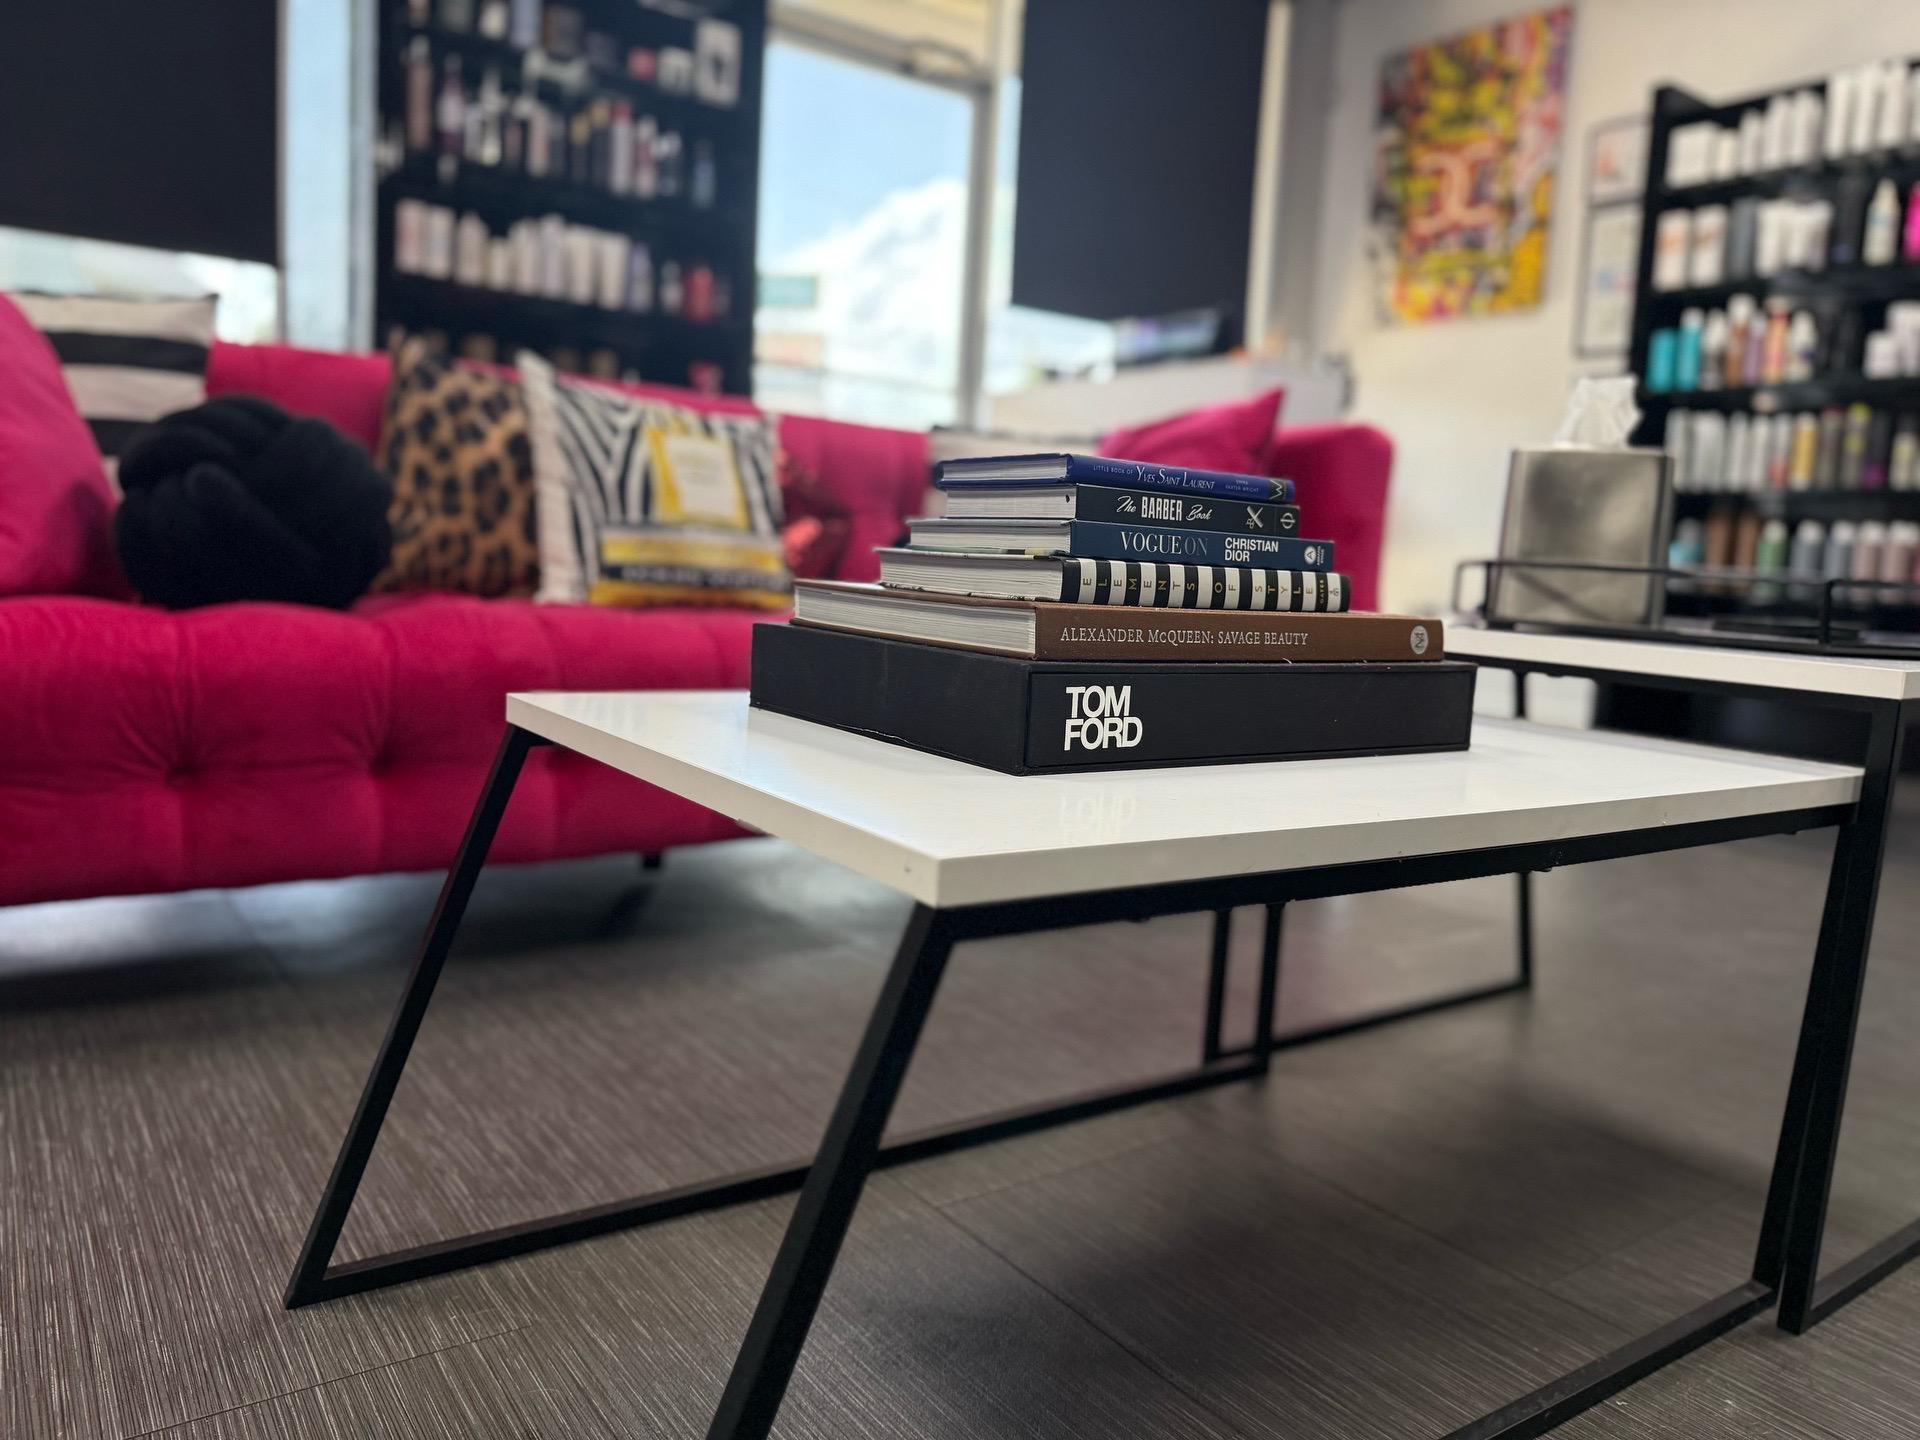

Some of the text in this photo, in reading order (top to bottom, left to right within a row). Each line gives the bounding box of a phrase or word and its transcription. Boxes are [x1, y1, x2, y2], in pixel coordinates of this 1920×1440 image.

[1136, 465, 1155, 483] YVES
[1157, 468, 1180, 486] SAINT
[1182, 471, 1215, 490] LAURENT
[1116, 495, 1213, 521] The BARBER Book
[1120, 531, 1208, 556] VOGUE ON
[1224, 537, 1279, 553] CHRISTIAN
[1224, 550, 1250, 562] DIOR
[1060, 627, 1309, 646] ALEXANDER McQUEEN: SAVAGE BEAUTY
[1065, 685, 1131, 718] TOM
[1064, 716, 1143, 751] FORD
